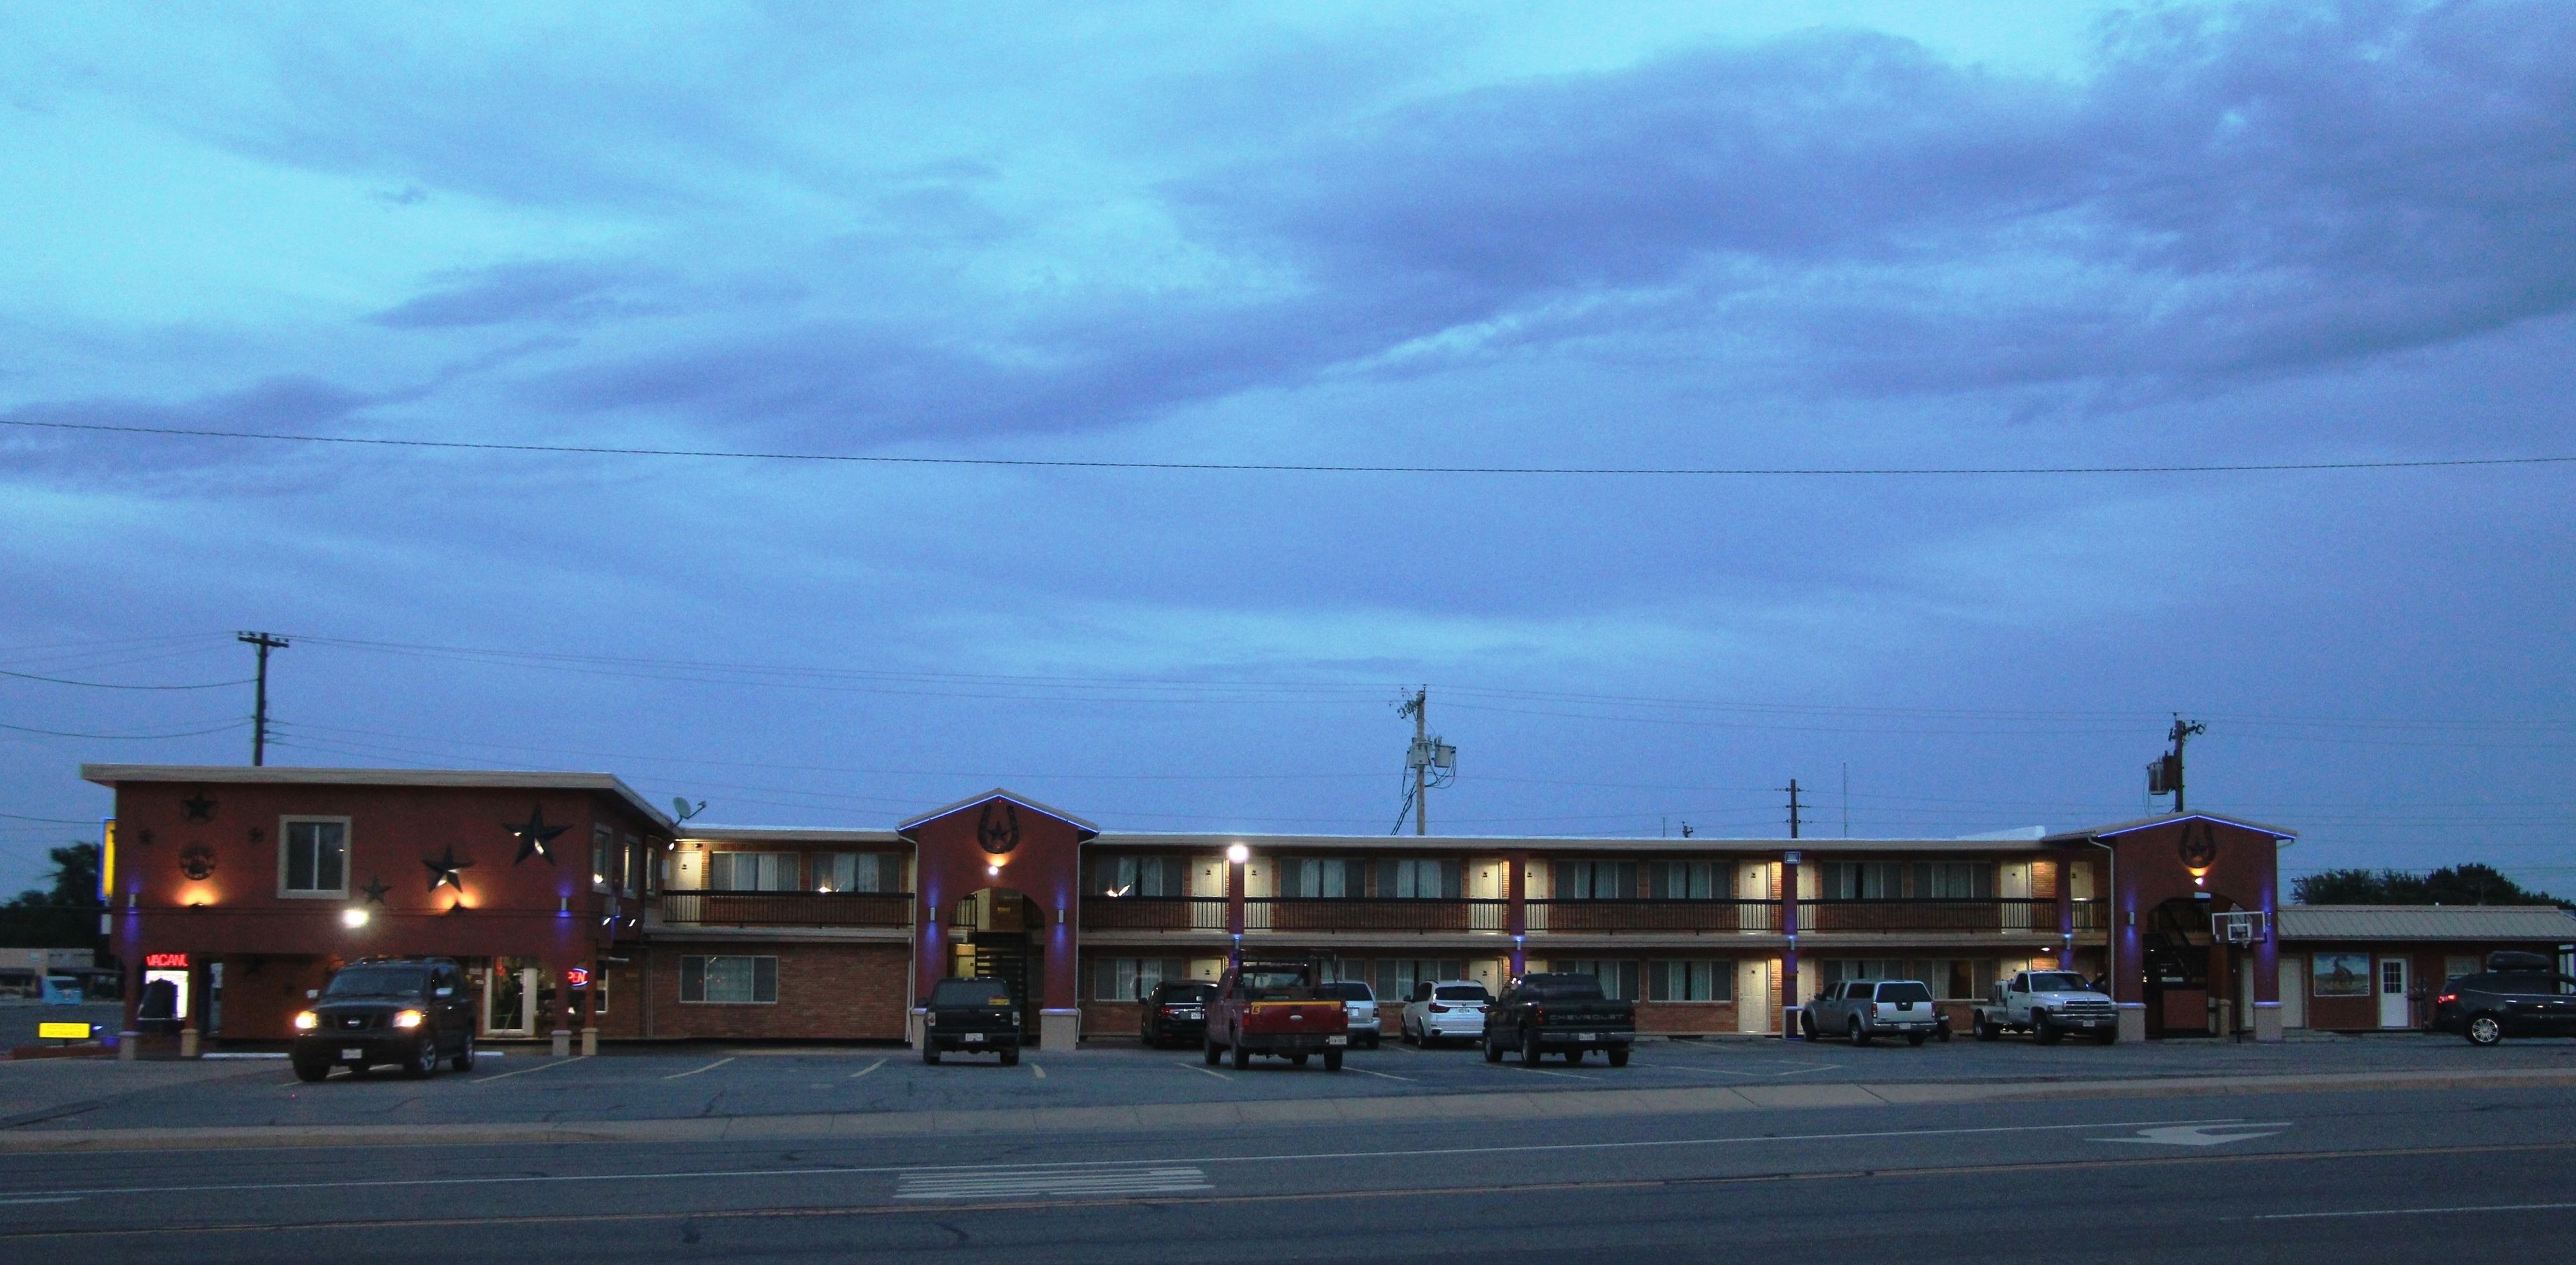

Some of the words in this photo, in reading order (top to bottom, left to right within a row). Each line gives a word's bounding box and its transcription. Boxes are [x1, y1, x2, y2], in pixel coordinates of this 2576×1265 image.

[146, 954, 188, 967] VACAN
[568, 971, 586, 983] PEN
[892, 1166, 1216, 1199] ONLY
